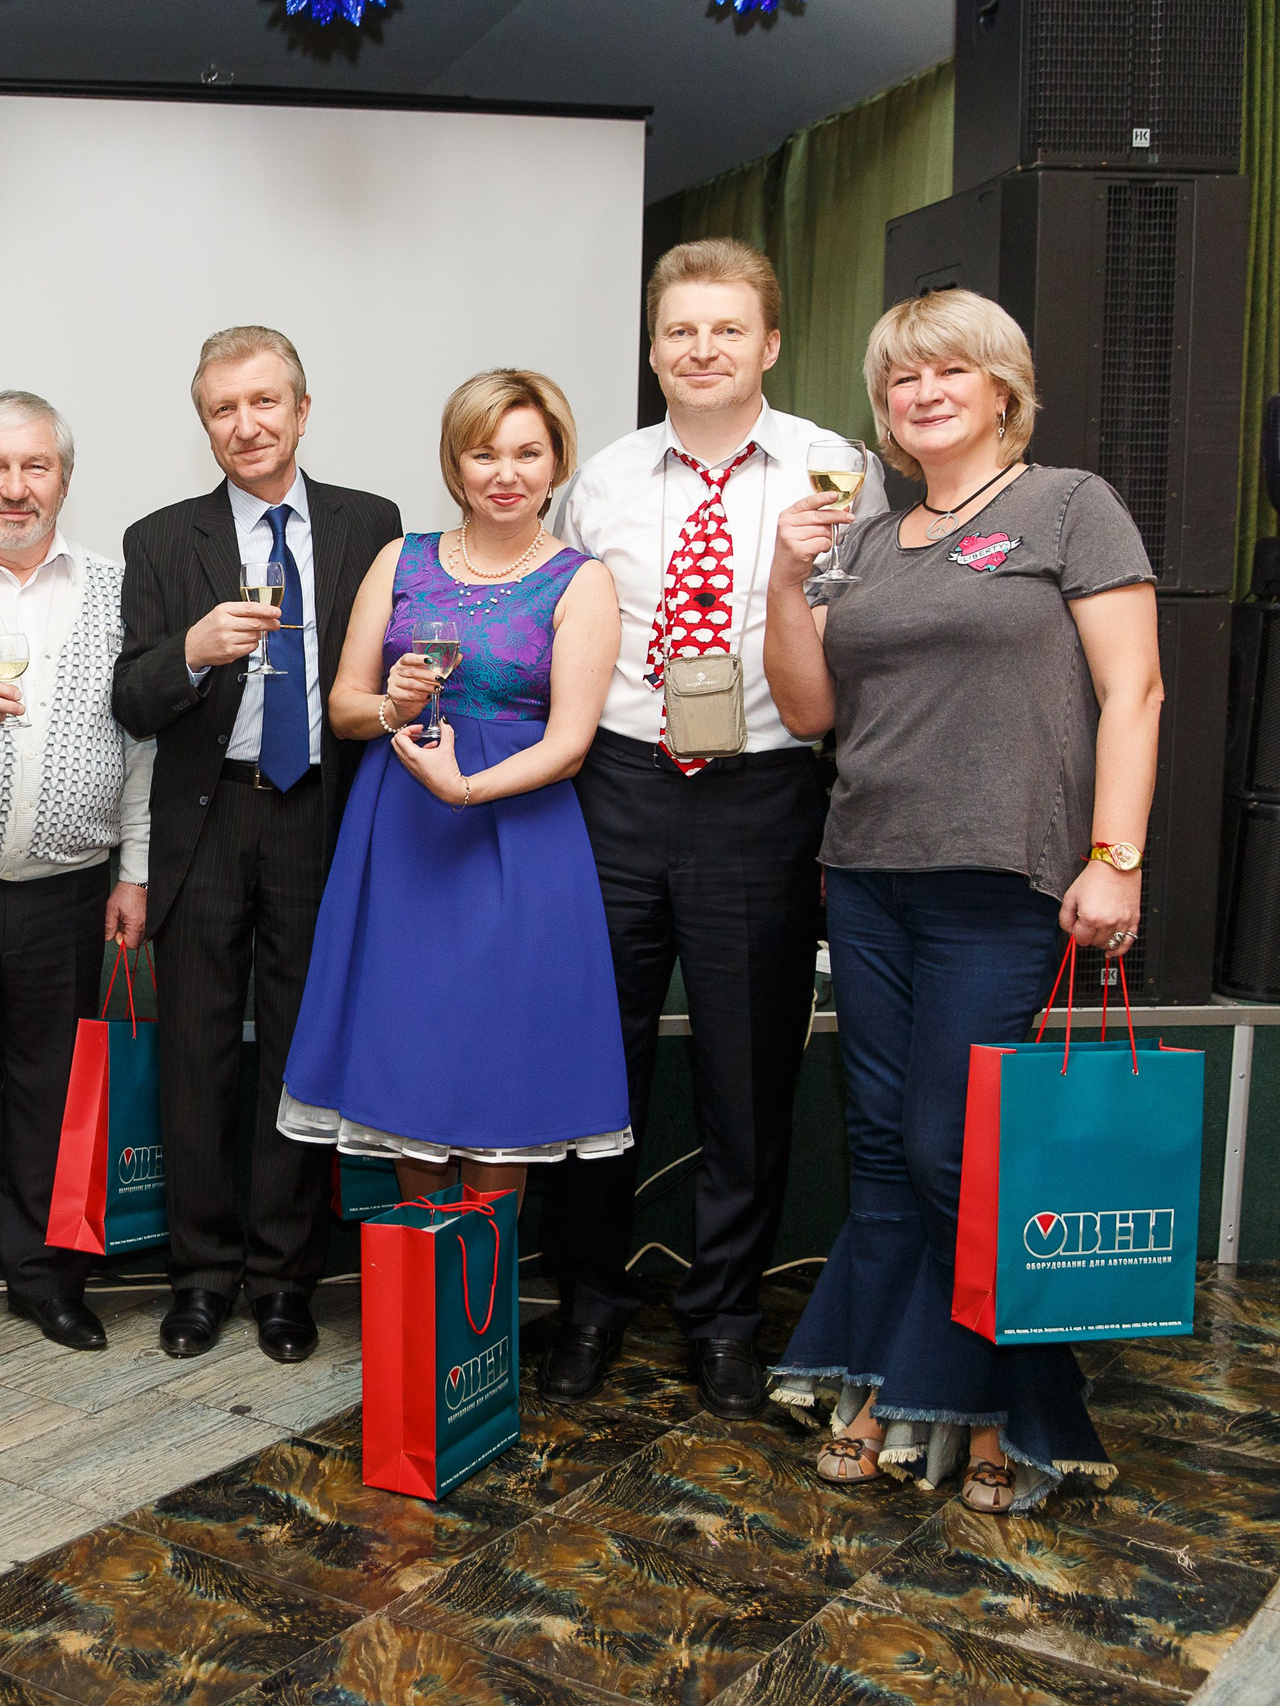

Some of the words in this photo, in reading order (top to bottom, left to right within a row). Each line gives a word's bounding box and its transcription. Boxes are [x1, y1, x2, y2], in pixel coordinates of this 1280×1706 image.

[1134, 130, 1148, 141] HK
[963, 542, 1006, 562] LIBERTY
[1023, 1208, 1175, 1259] ОВЕН
[1025, 1259, 1086, 1270] ОБОРУДОВАНИЕ
[1089, 1259, 1106, 1268] ДЛЯ
[1108, 1256, 1173, 1266] АВТОМАТИЗАЦИИ
[445, 1335, 509, 1410] ОВЕН
